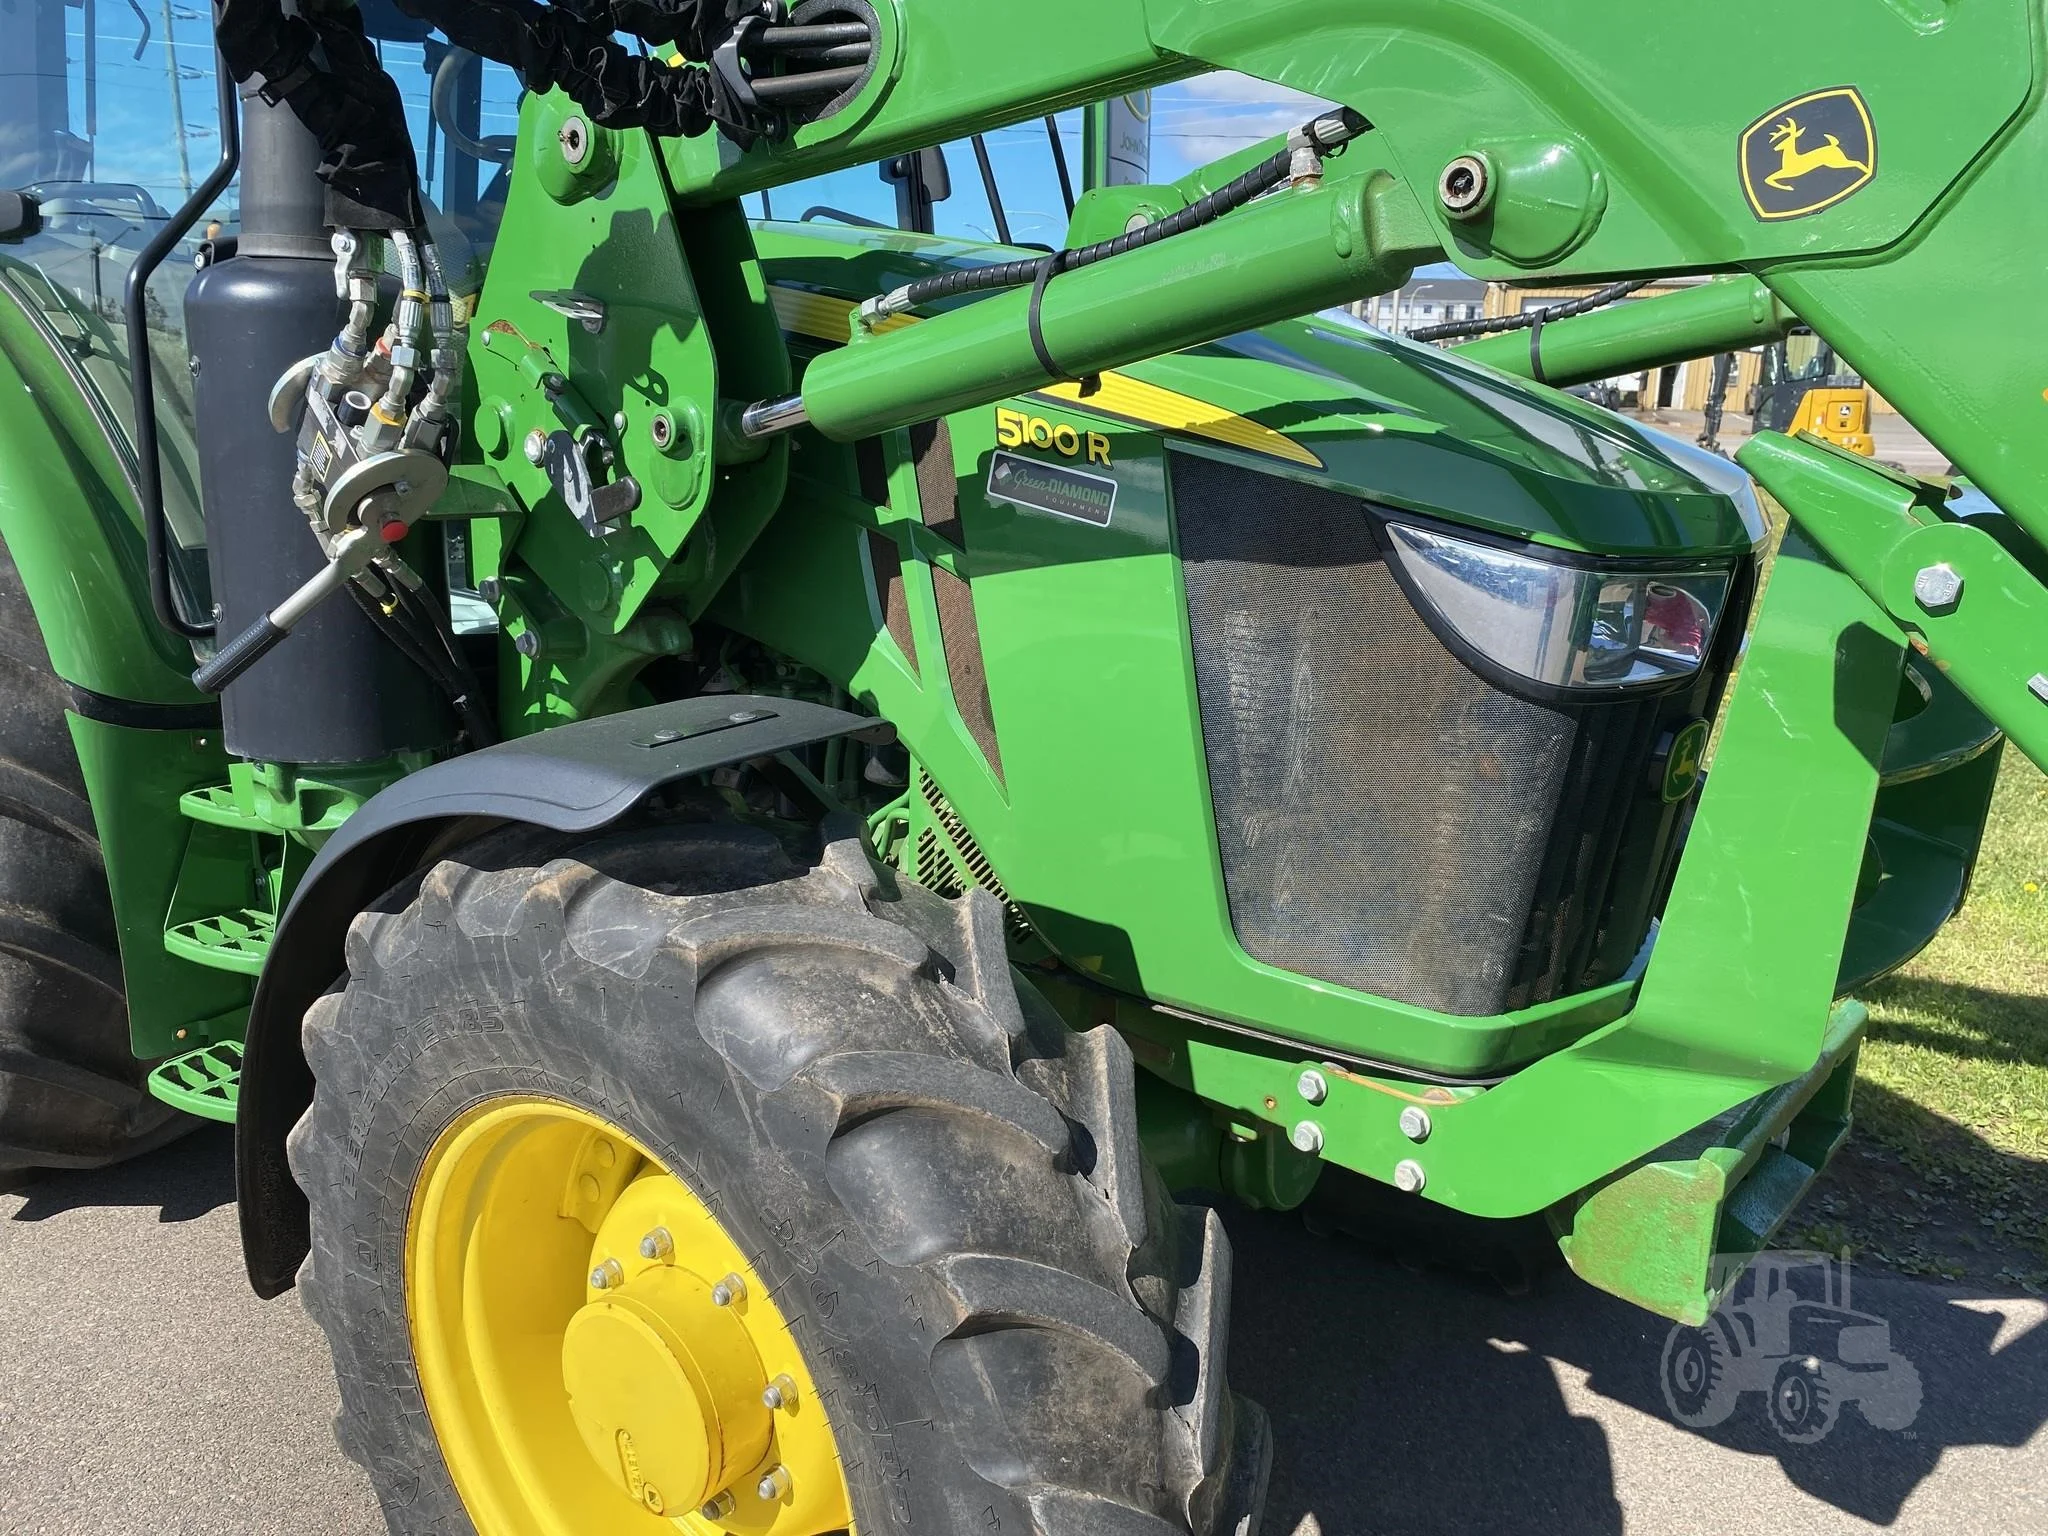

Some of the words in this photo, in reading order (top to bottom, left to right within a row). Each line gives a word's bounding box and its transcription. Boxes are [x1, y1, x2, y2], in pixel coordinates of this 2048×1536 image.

[996, 406, 1080, 457] 5100
[1086, 431, 1113, 470] R
[1013, 468, 1050, 491] Green
[1048, 478, 1110, 508] DIAMOND
[1045, 496, 1107, 516] EQUIPMENT
[458, 1004, 505, 1035] 85
